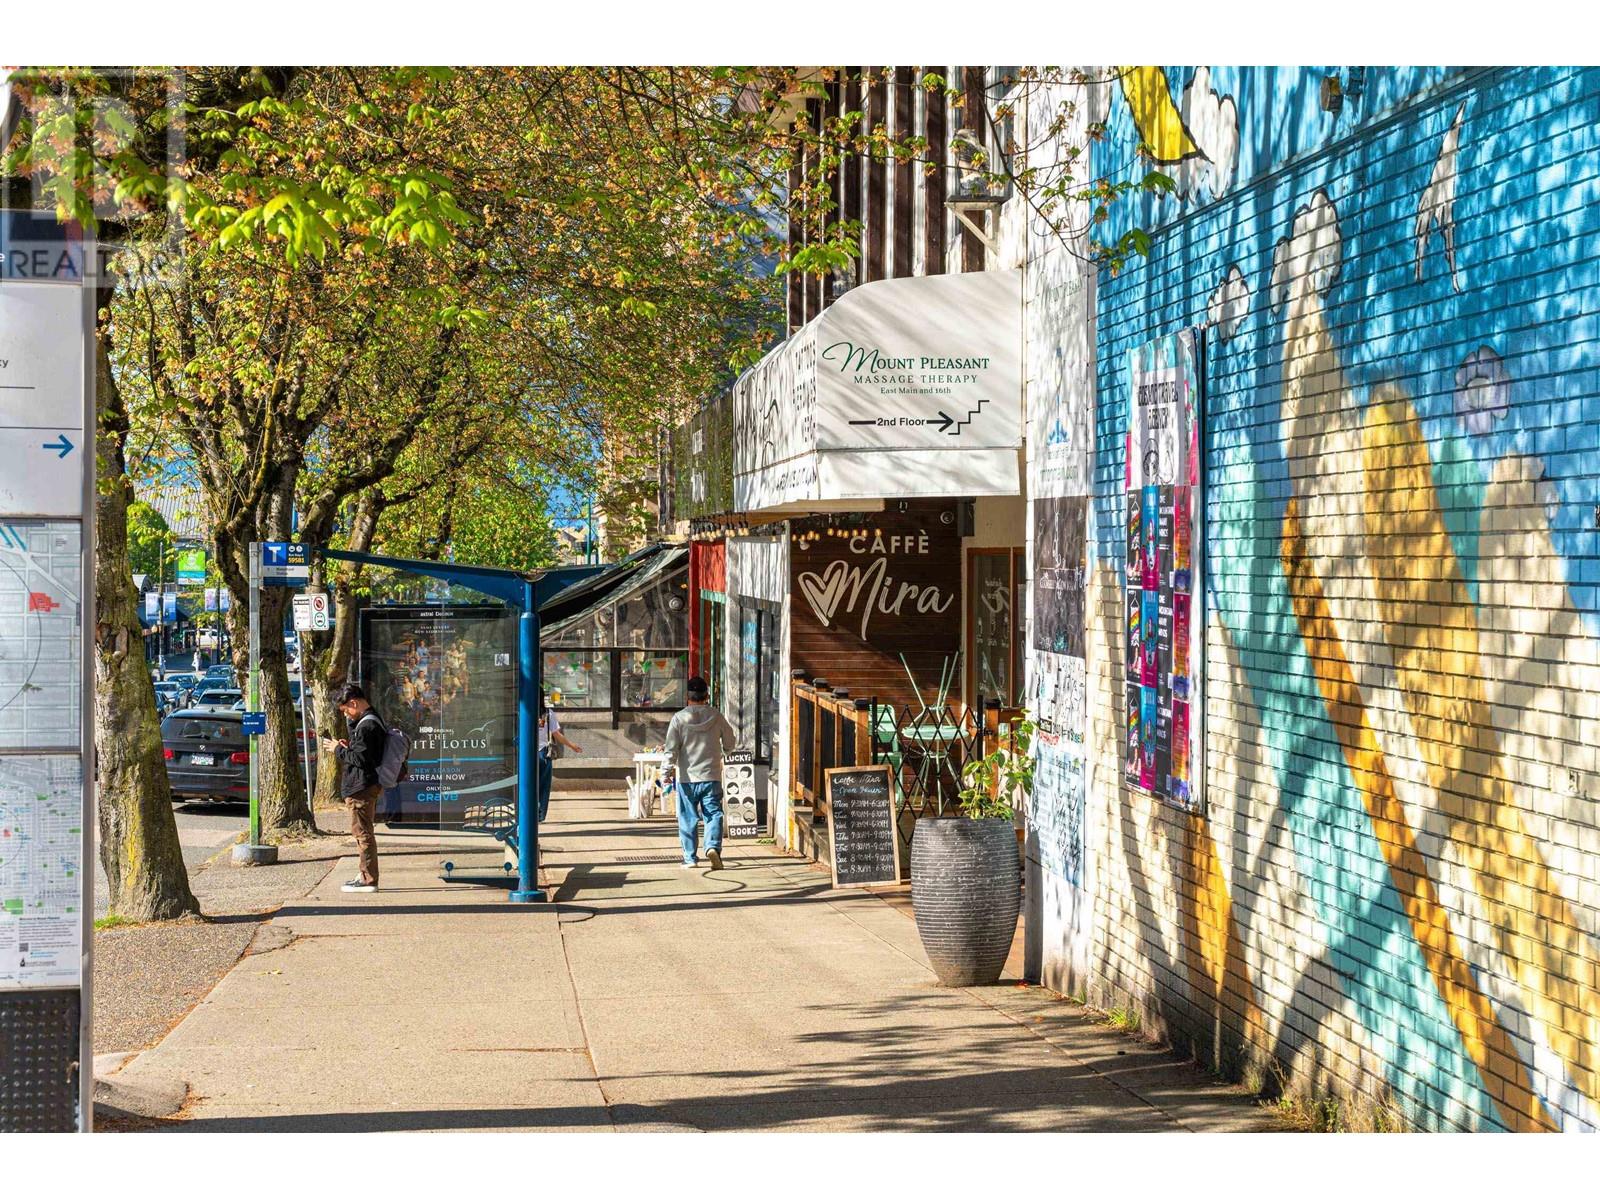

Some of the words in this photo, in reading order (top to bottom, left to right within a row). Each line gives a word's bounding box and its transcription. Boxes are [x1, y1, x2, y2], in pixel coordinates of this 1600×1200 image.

[822, 342, 914, 373] MOUNT
[921, 357, 990, 370] PLEASANT
[854, 375, 914, 384] MASSAGE
[921, 375, 978, 384] THERAPY
[880, 387, 897, 395] East
[898, 387, 918, 395] Main
[919, 387, 934, 395] and
[877, 417, 897, 427] 2nd
[899, 417, 926, 427] Floor
[849, 530, 929, 554] CAFFÈ
[822, 557, 954, 641] Mira
[419, 726, 433, 734] HBO
[414, 739, 436, 750] ITE
[443, 739, 486, 749] LOTUS
[409, 774, 442, 782] STREAM
[730, 827, 757, 837] BOOKS
